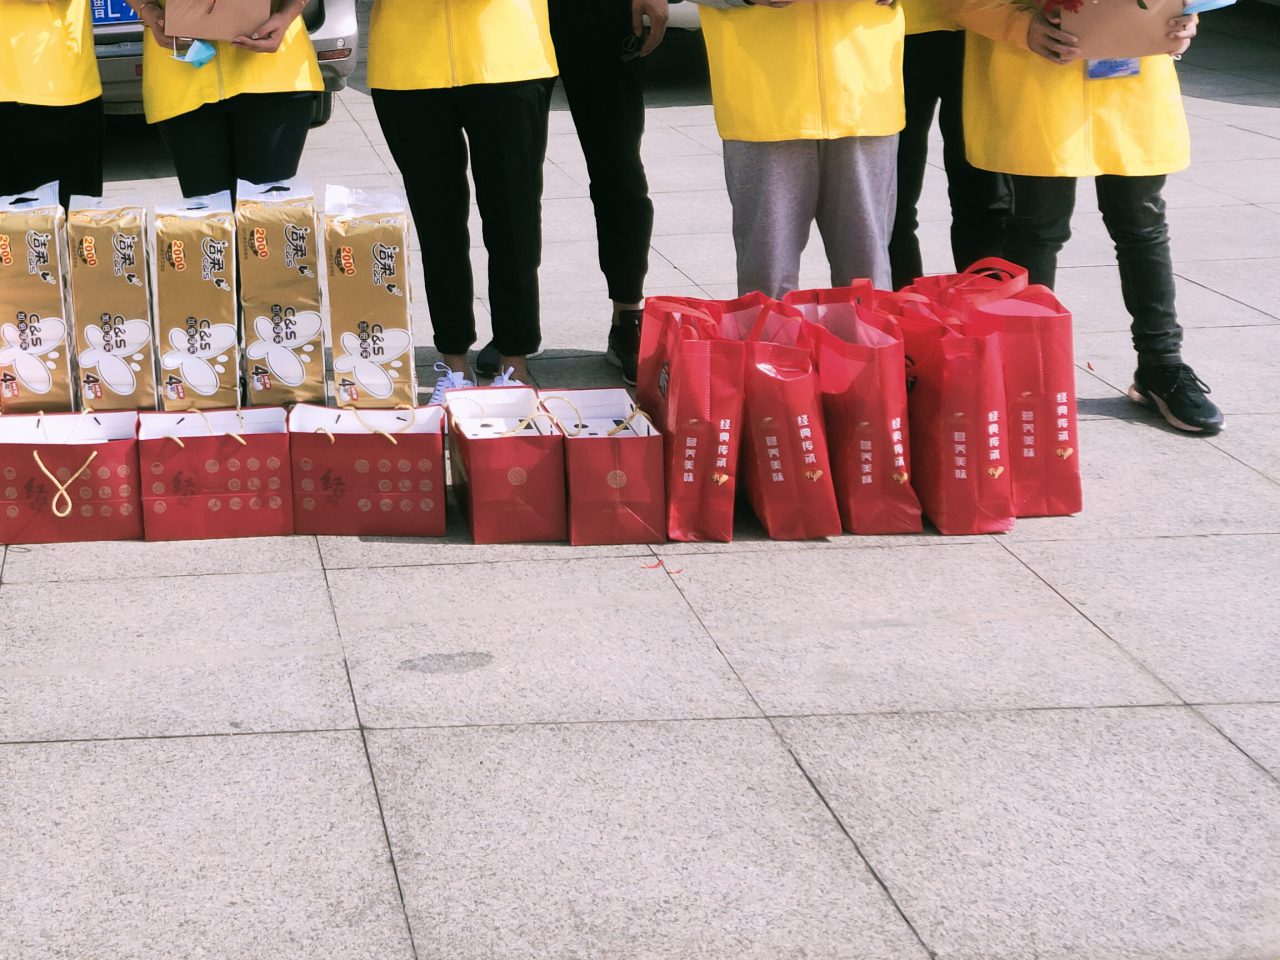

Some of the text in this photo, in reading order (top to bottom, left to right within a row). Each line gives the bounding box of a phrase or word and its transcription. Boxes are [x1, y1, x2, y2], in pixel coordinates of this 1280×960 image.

[0, 234, 13, 266] 2000
[84, 236, 97, 267] 2000
[172, 240, 186, 271] 2000
[255, 227, 269, 259] 2000
[341, 246, 355, 277] 2000
[29, 313, 42, 347] C&S
[113, 315, 127, 349] C&S
[199, 319, 211, 351] C&S
[284, 306, 297, 340] C&S
[371, 324, 384, 356] C&S
